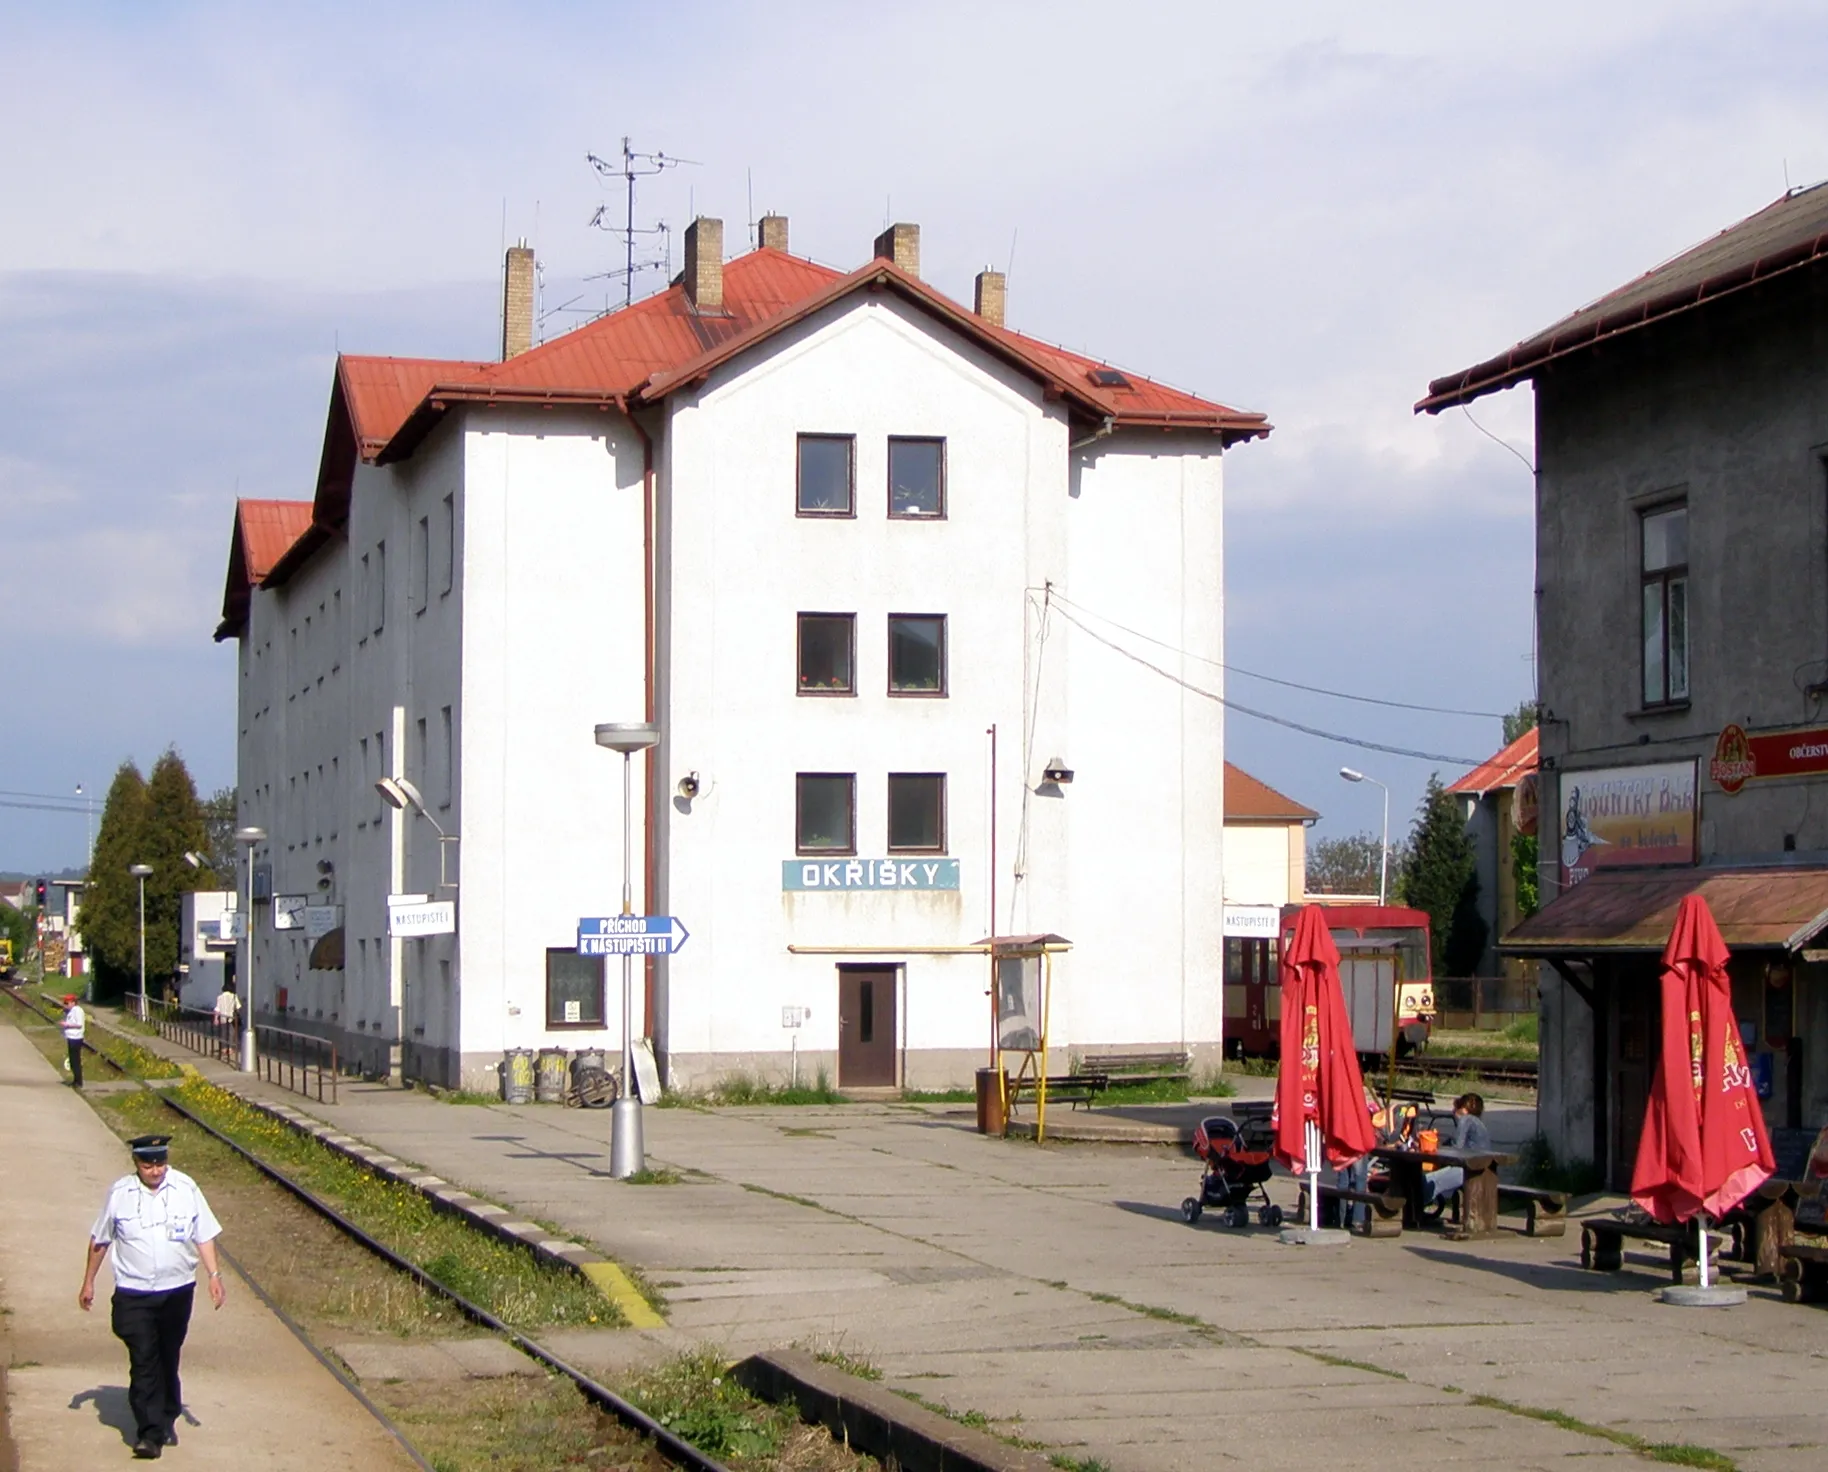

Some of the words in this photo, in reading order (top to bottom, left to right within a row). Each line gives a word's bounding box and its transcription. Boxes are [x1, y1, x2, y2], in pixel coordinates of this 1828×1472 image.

[802, 860, 939, 886] OKŘÍŠKY
[599, 917, 647, 934] PŘÍCHOD
[580, 938, 588, 954] K
[591, 937, 655, 954] NÁSTUPIŠTI
[657, 938, 667, 953] II
